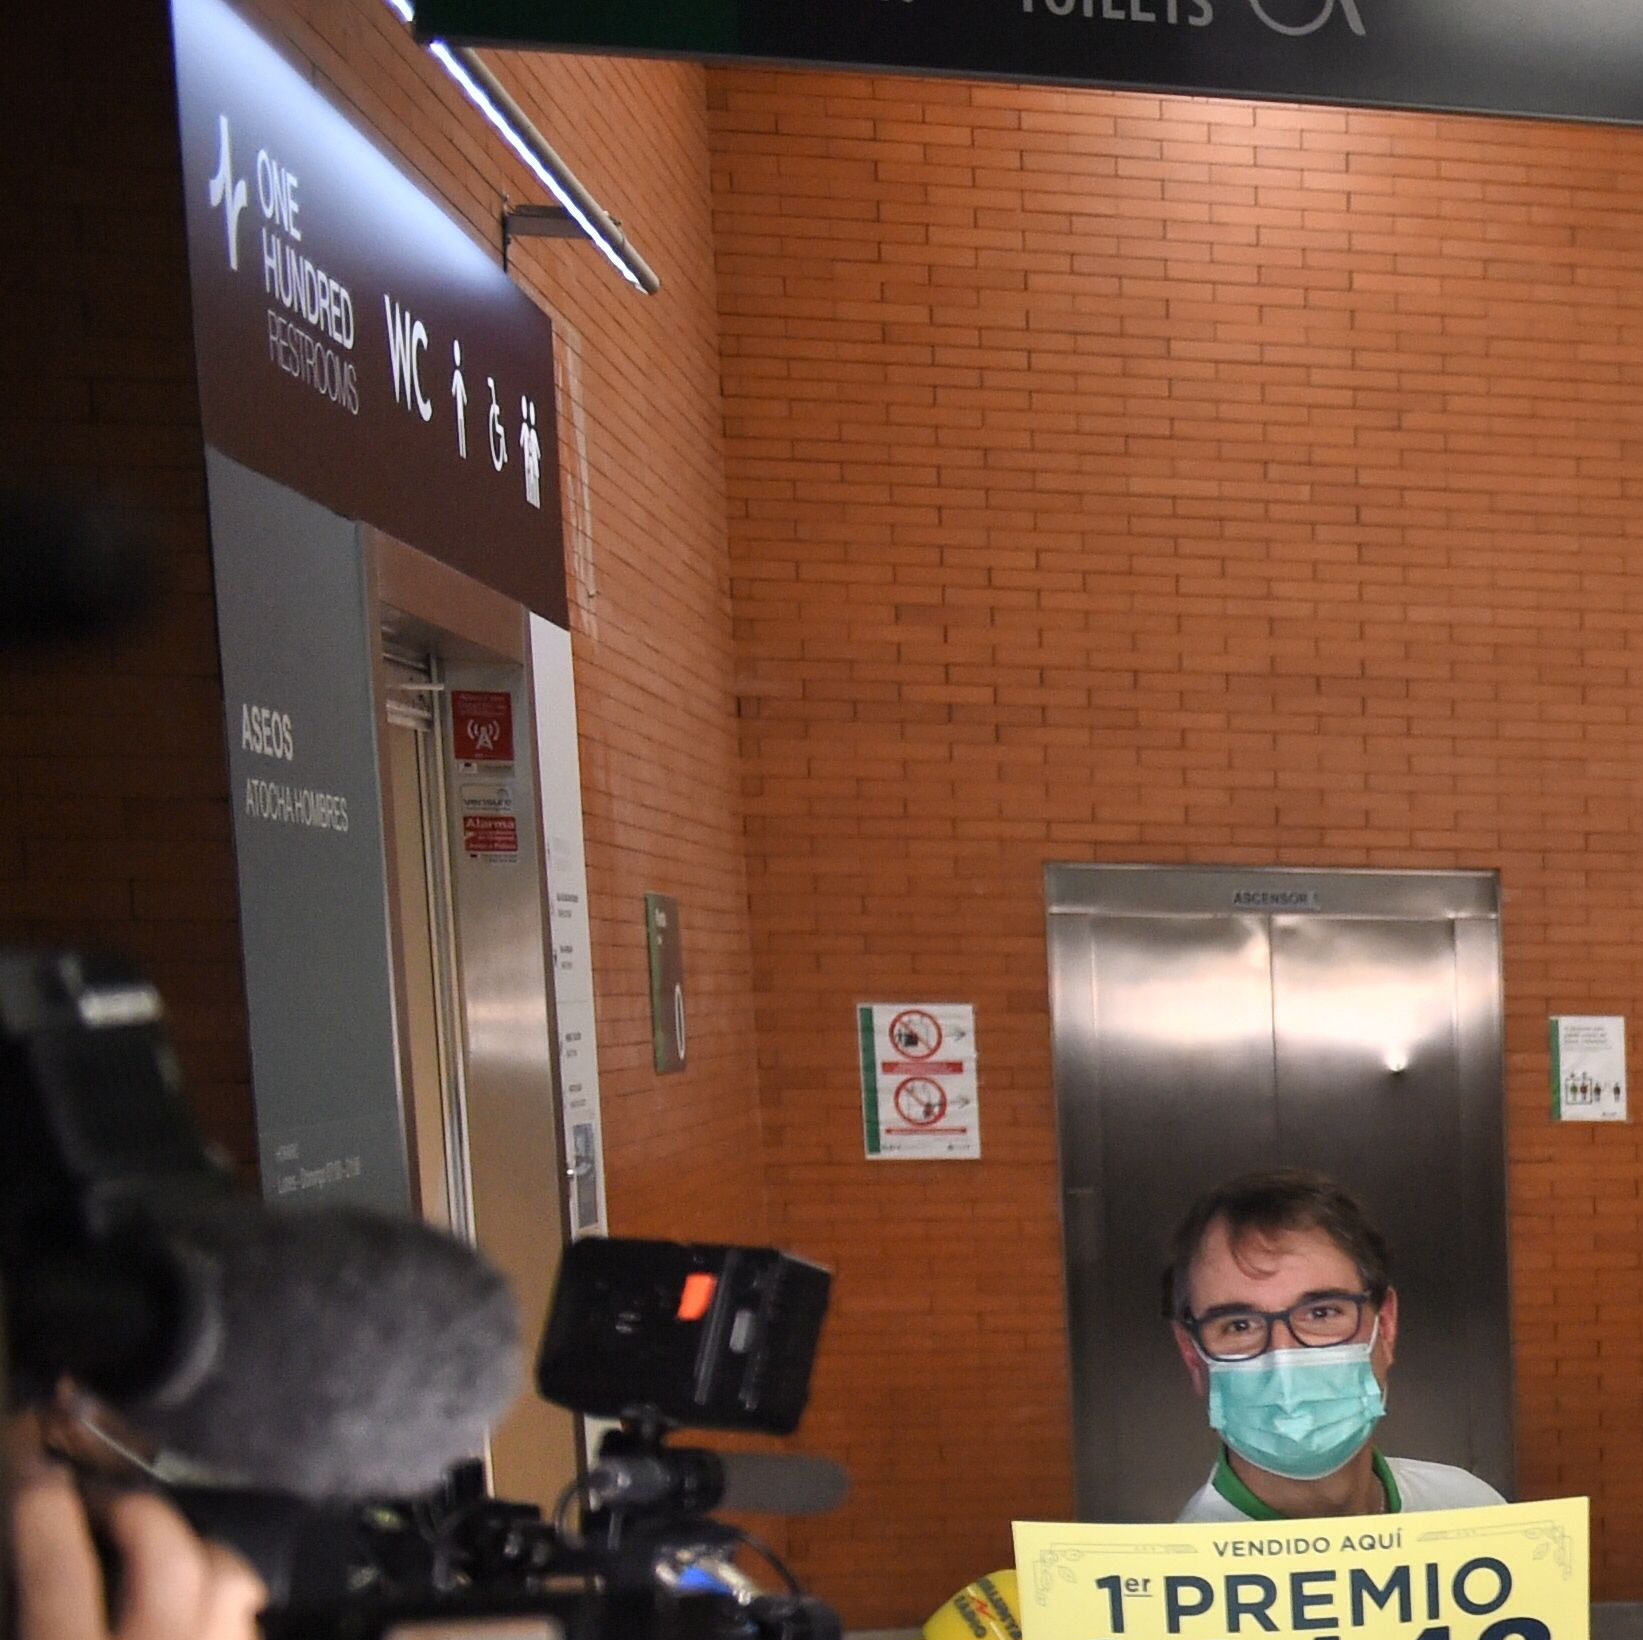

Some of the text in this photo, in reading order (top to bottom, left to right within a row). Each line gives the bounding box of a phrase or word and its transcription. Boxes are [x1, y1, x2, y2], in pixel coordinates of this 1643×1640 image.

[257, 149, 301, 242] ONE
[262, 227, 354, 350] HUNDRED
[267, 309, 359, 416] RESTROOMS
[384, 294, 432, 422] WC
[242, 703, 293, 761] ASEOS
[246, 778, 348, 832] ATOCHA HOMBRES
[1233, 892, 1308, 905] ASCENSOR
[1213, 1528, 1403, 1557] VENDIDO AQUÍ
[1095, 1574, 1153, 1634] 1er
[1163, 1557, 1513, 1634] PREMIO
